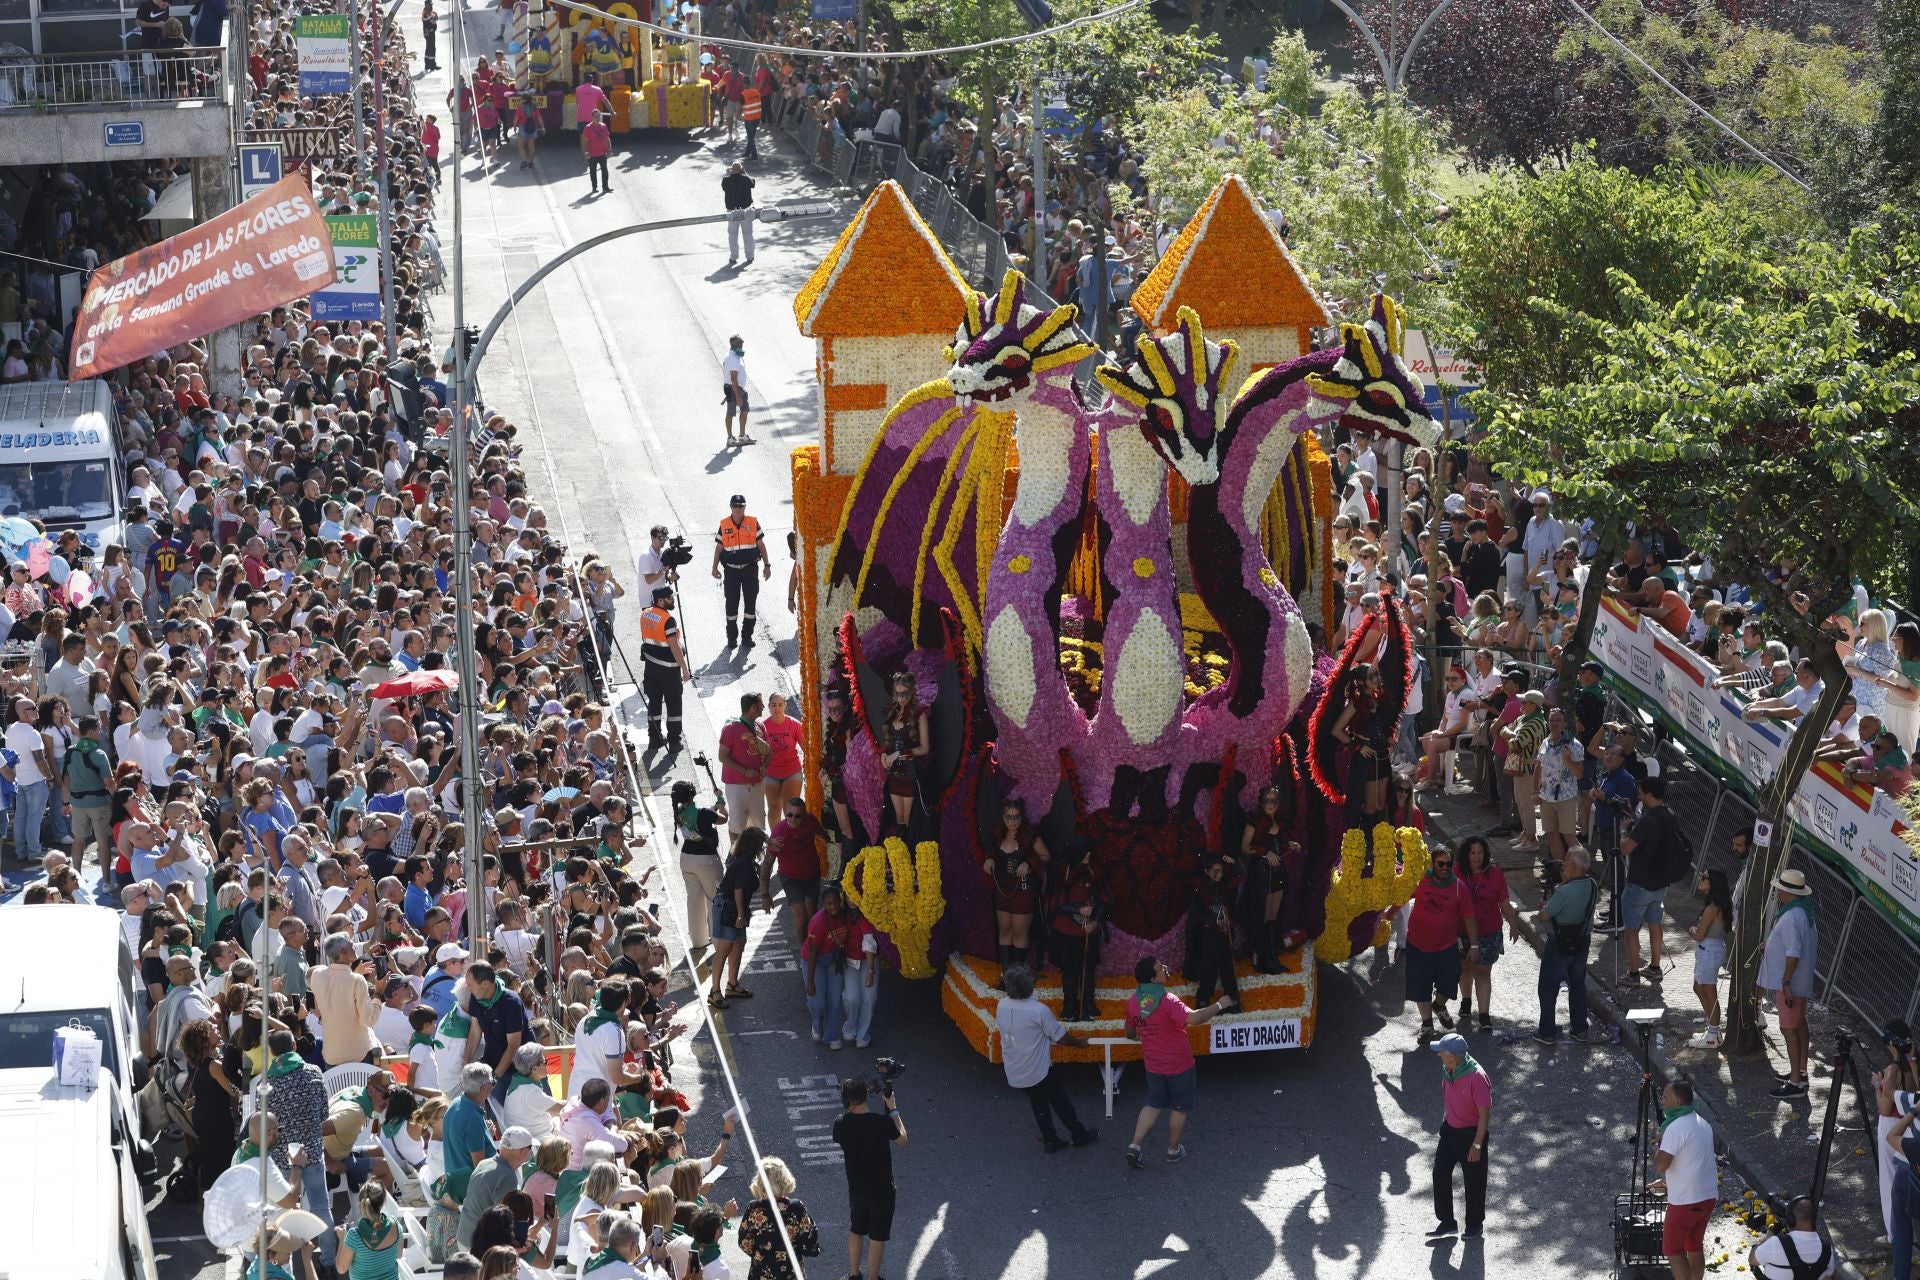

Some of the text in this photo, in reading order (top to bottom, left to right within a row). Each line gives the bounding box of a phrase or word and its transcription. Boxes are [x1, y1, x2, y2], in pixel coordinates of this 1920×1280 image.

[302, 20, 343, 28] BATALLA
[326, 221, 370, 233] ATALLA
[91, 195, 313, 314] MERCADO DE LAS FLORES
[87, 234, 321, 339] en la Semana Grande de Laredo
[0, 429, 100, 449] ELADERIA
[157, 554, 175, 571] 10
[1819, 803, 1834, 820] AEDAS
[1817, 813, 1833, 831] HOMES
[1895, 863, 1912, 881] AEDAS
[1895, 873, 1913, 892] HOMES
[1215, 1019, 1295, 1049] EL REY DRAGÓN
